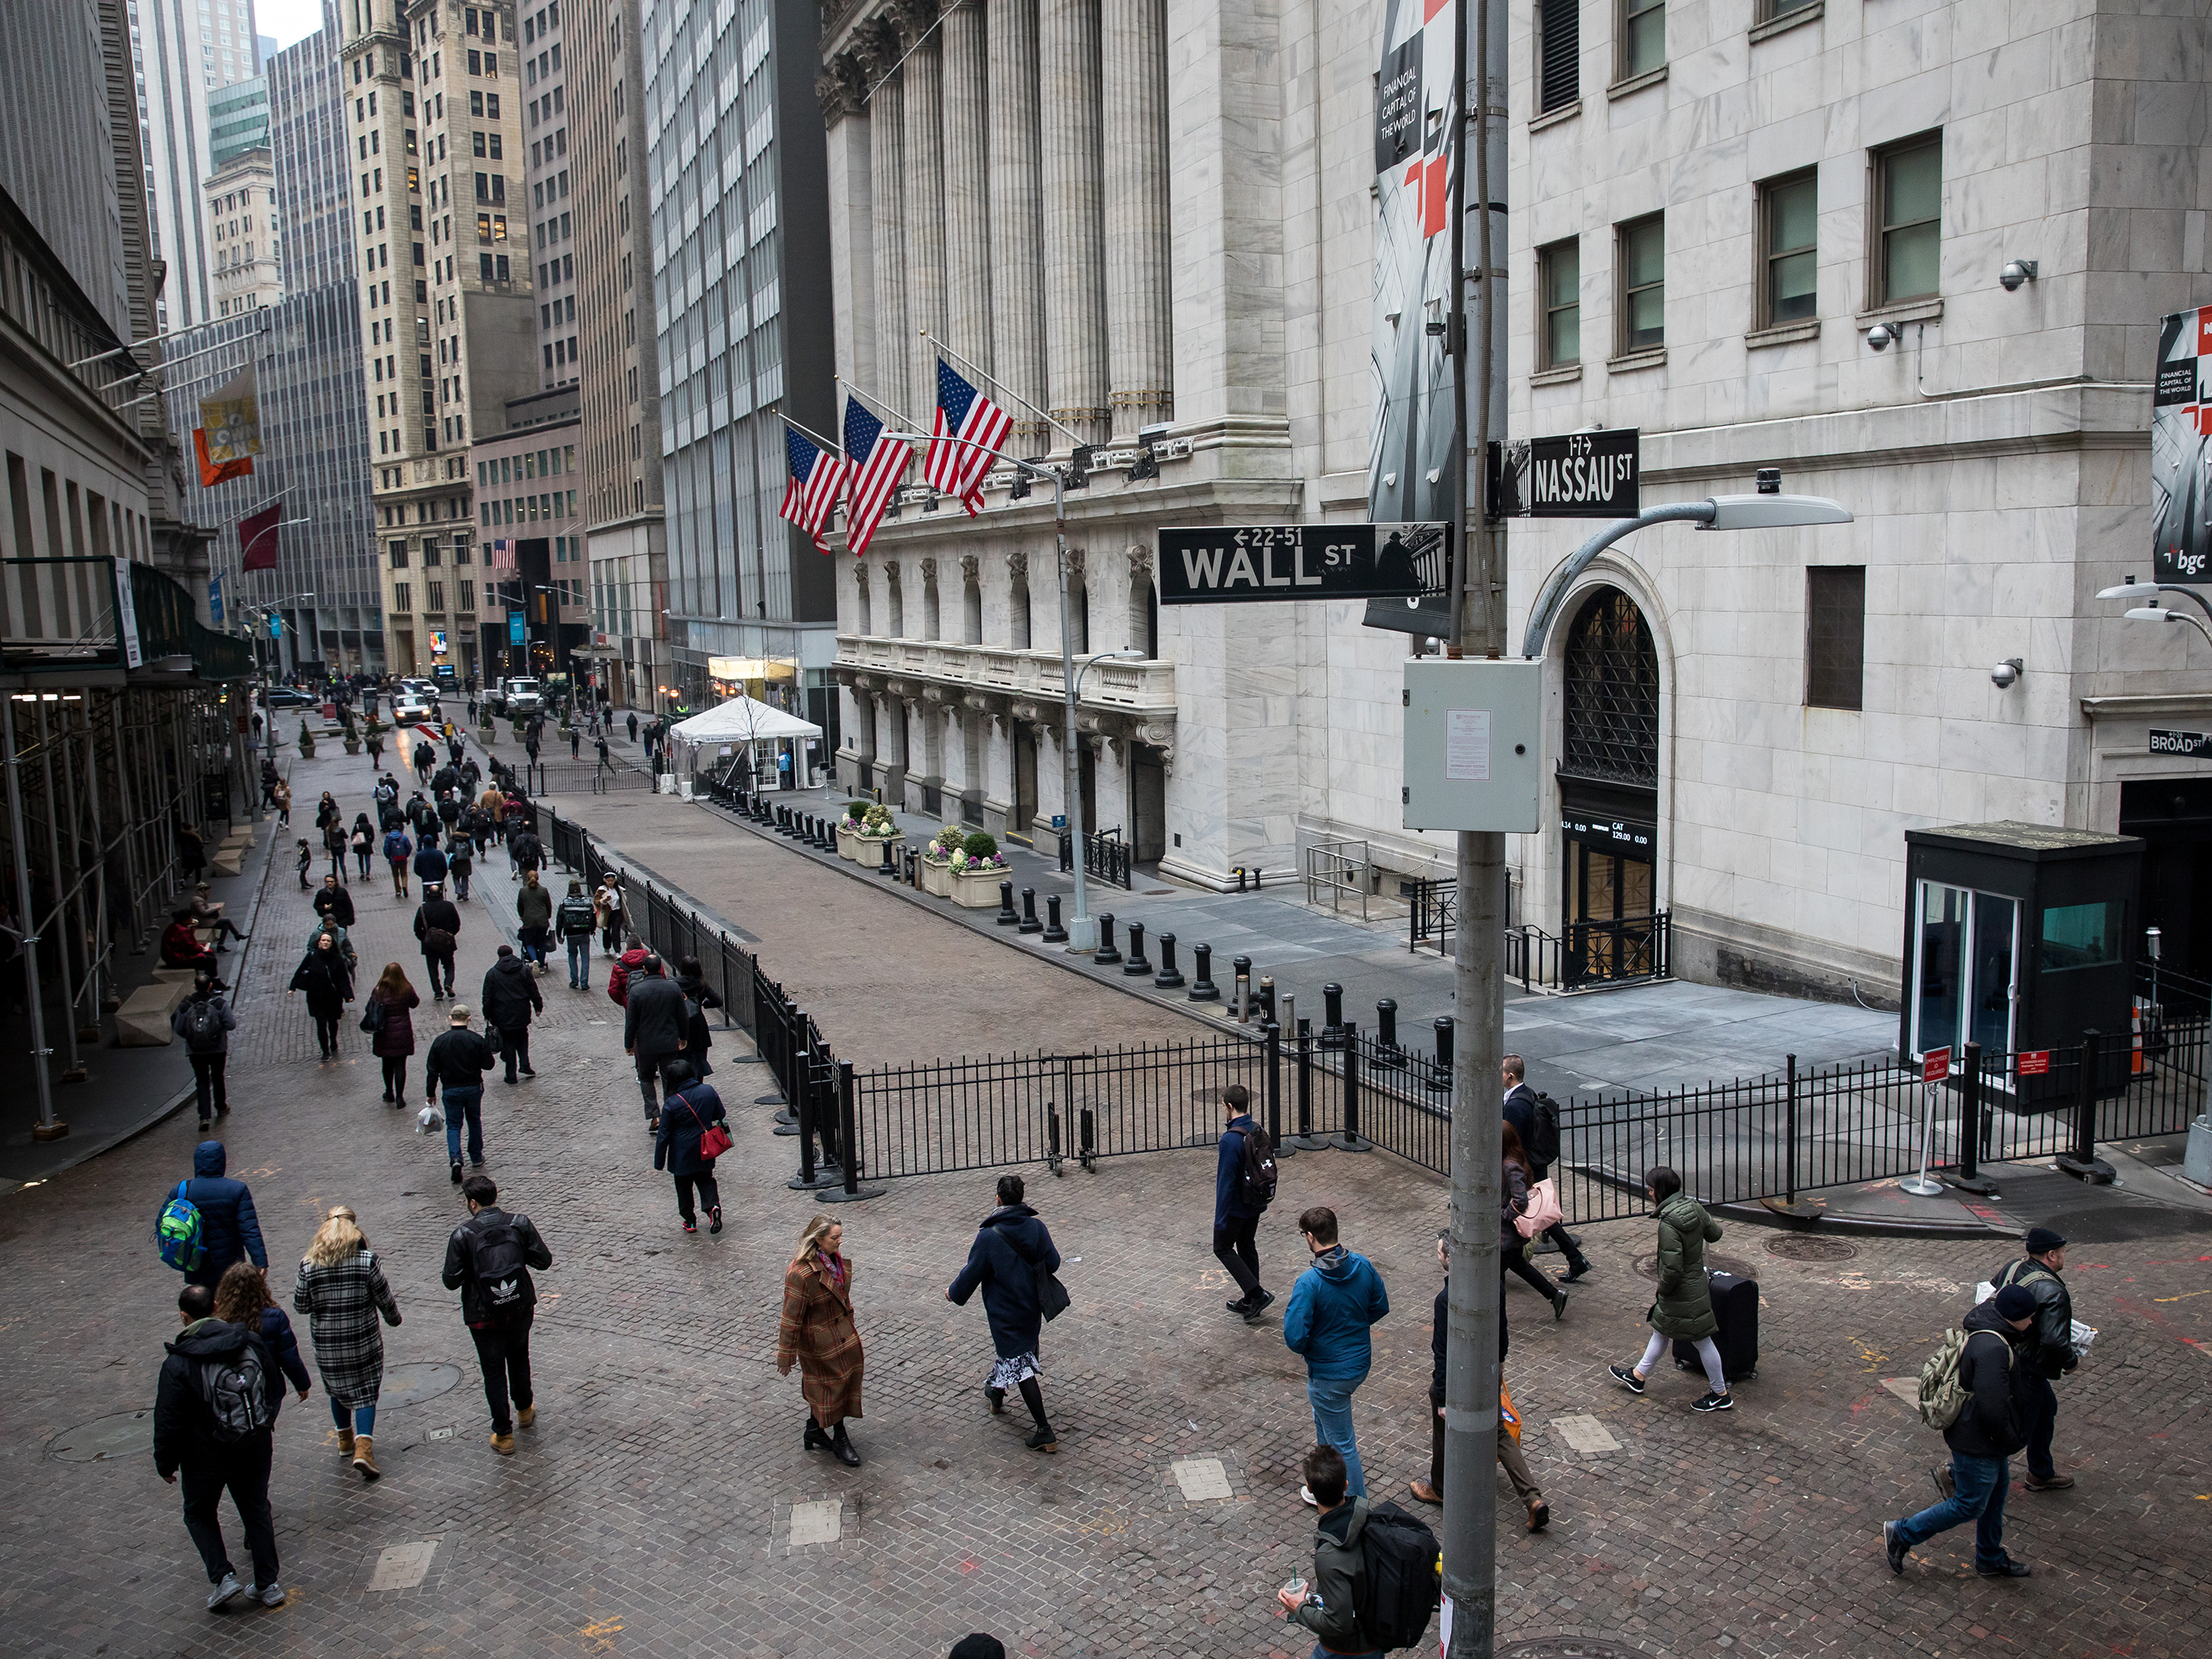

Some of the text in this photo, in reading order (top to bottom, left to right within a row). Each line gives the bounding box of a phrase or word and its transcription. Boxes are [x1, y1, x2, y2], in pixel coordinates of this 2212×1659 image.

[1383, 66, 1417, 100] FINANCIAL
[1382, 86, 1417, 120] CAPITAL OF
[1381, 109, 1416, 140] THE WORLD
[2161, 369, 2192, 379] FINANCIAL
[2160, 379, 2183, 388] CAPITAL
[2160, 384, 2192, 395] THE WORLD
[1568, 436, 1583, 456] 1-7
[1534, 453, 1633, 503] NASSAU ST
[1251, 527, 1303, 547] 22-51
[1181, 545, 1356, 590] WALL ST
[2177, 550, 2205, 575] bgc
[2151, 736, 2202, 752] BROAD ST
[1574, 823, 1587, 832] 0.00
[1613, 822, 1624, 831] CAT
[1613, 831, 1647, 845] 129.00 0.00
[492, 1293, 521, 1305] adidas
